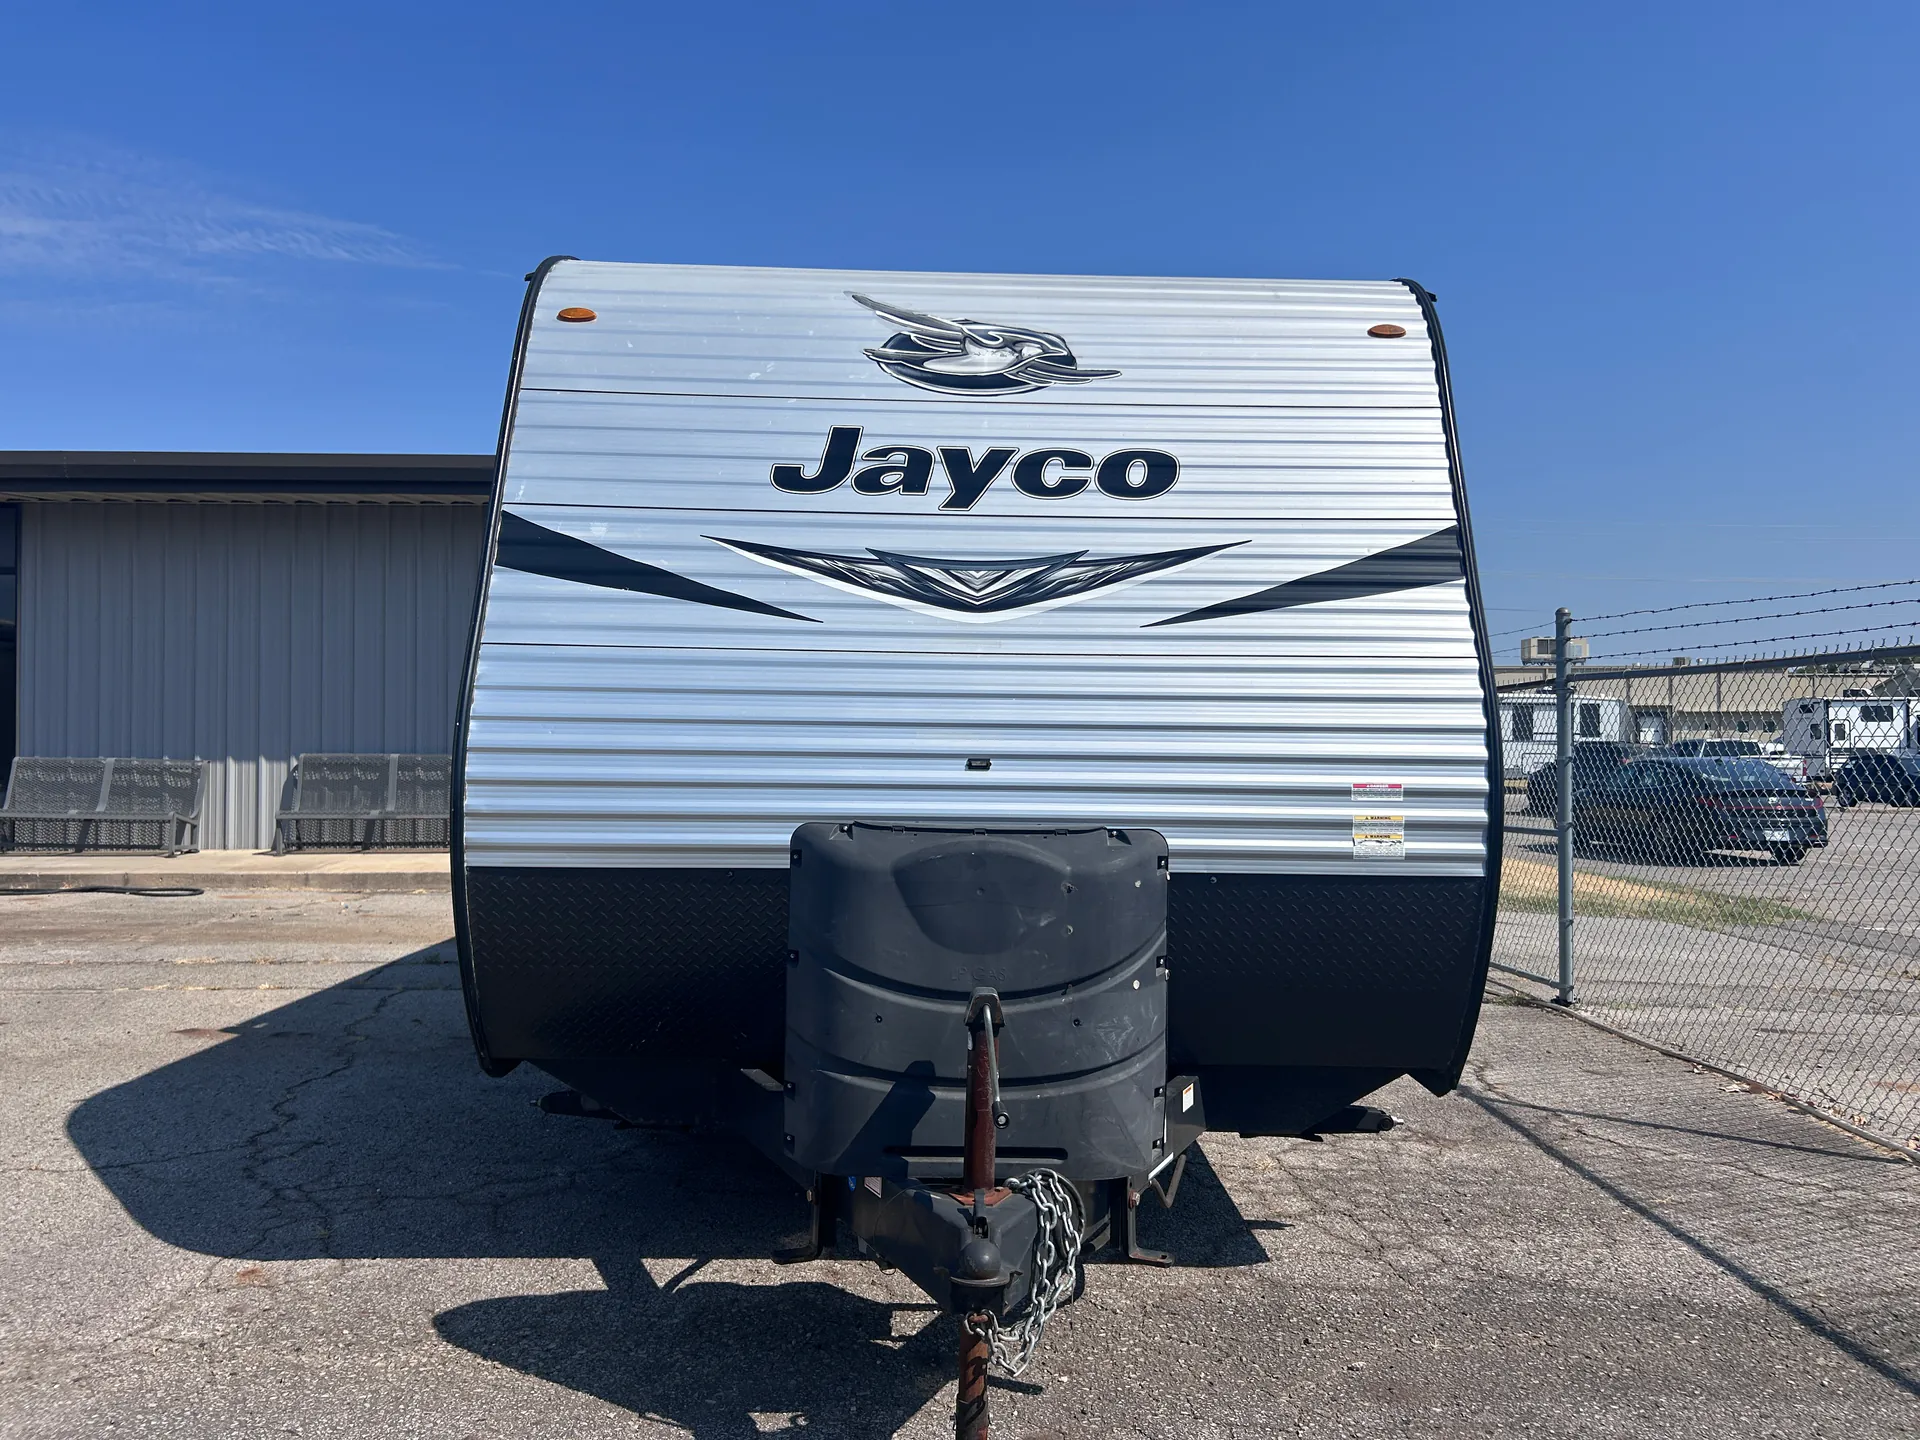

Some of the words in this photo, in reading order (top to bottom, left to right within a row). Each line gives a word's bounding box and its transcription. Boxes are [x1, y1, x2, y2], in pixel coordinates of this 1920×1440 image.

[770, 425, 1181, 512] Jayco
[951, 966, 968, 981] LP
[971, 966, 1006, 981] GAS
